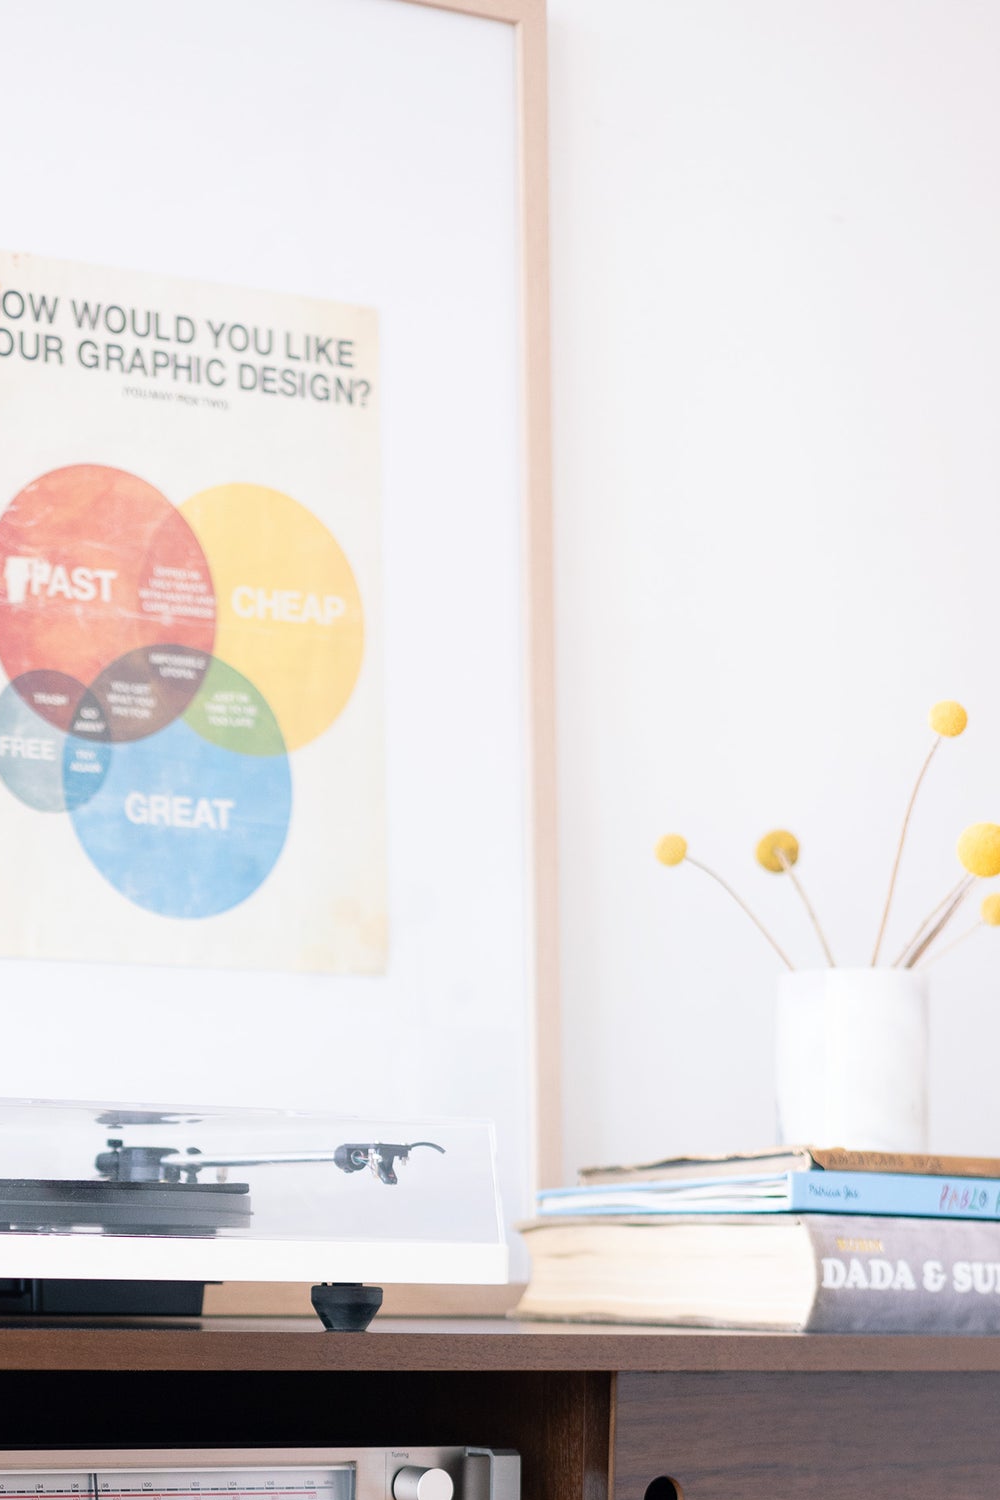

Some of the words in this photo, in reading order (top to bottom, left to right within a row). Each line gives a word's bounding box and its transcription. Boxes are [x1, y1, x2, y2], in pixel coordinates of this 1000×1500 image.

[71, 299, 197, 343] WOULD
[207, 320, 273, 356] YOU
[285, 332, 356, 368] LIKE
[77, 341, 227, 388] GRAPHIC
[238, 364, 371, 409] DESIGN?
[231, 586, 346, 626] CHEAP
[123, 791, 236, 831] GREAT
[822, 1257, 916, 1291] DADA
[922, 1260, 947, 1293] &
[391, 1451, 409, 1459] Tuning
